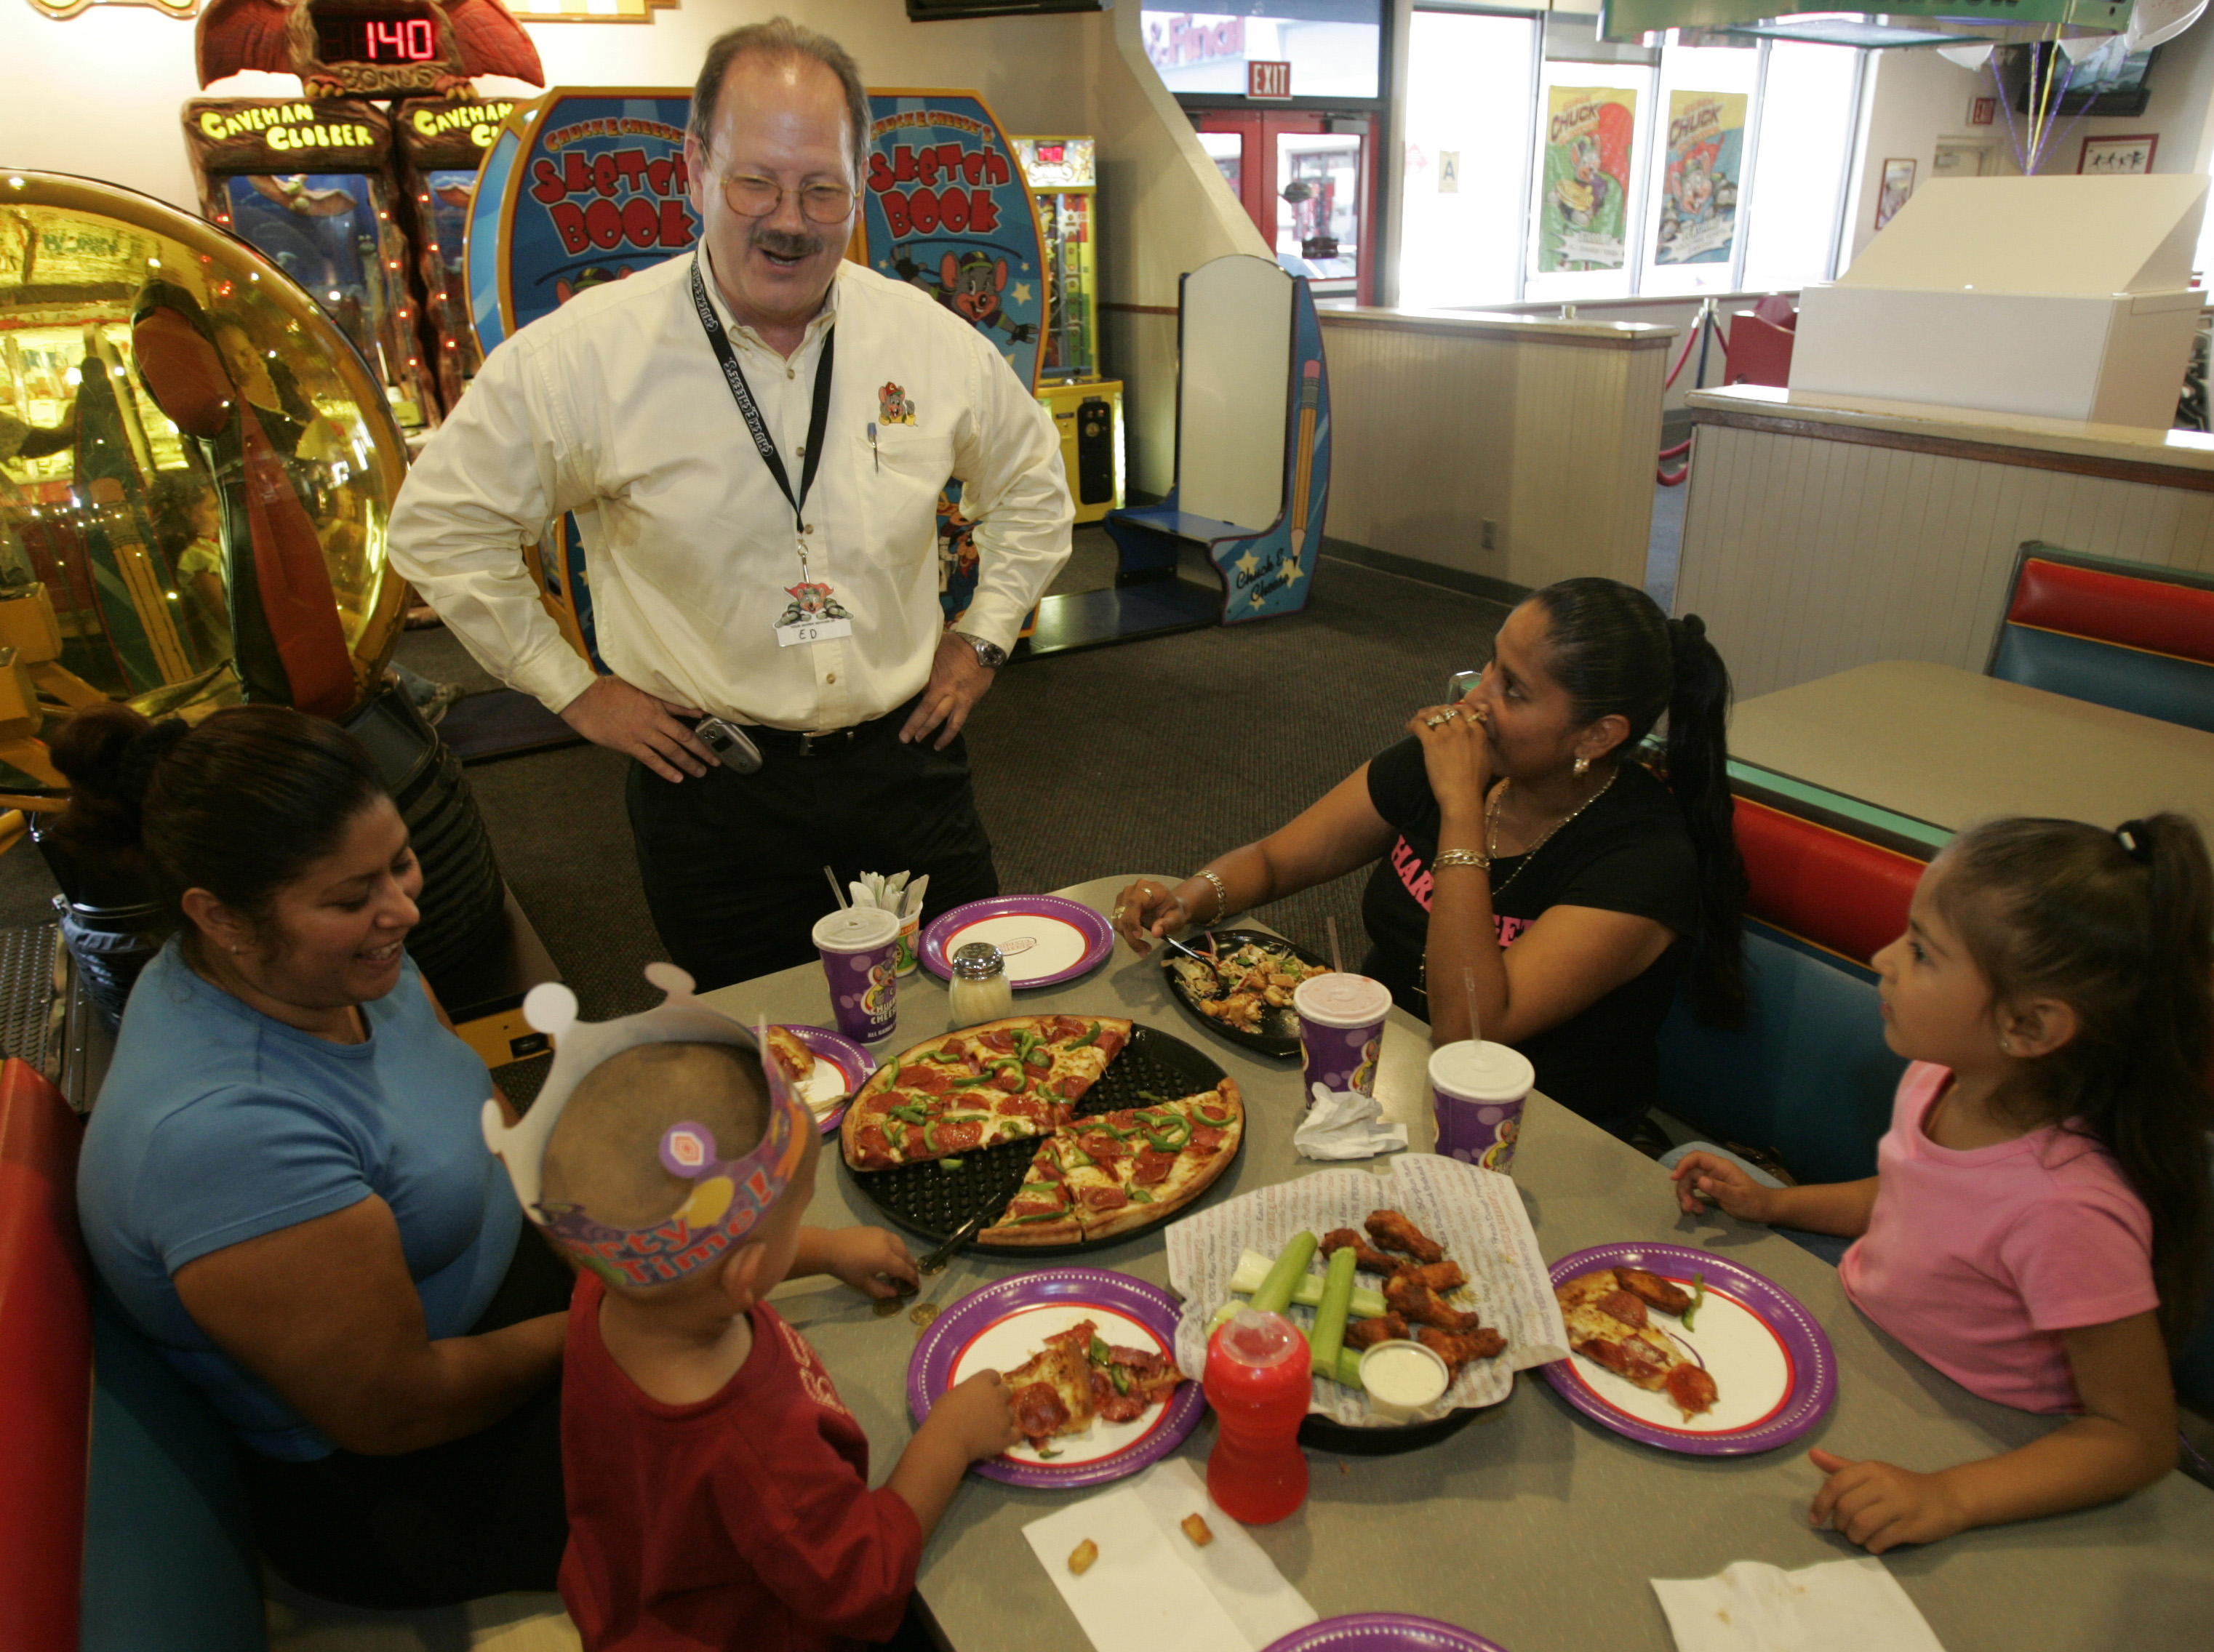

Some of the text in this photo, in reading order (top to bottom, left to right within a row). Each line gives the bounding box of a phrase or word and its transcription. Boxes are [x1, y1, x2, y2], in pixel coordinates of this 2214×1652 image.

[367, 20, 435, 60] 140
[1170, 13, 1244, 63] Final
[341, 68, 433, 91] BONUS
[1254, 64, 1287, 95] EXIT
[201, 103, 314, 140] CAVEMAN
[413, 103, 514, 137] CAVEMAN
[545, 119, 604, 151] CHUCK
[621, 118, 686, 144] CHEESE'
[266, 125, 374, 151] CLOBBER
[1442, 160, 1455, 180] A
[1236, 555, 1274, 590] Chuck
[560, 1218, 691, 1259] rty
[1208, 1281, 1217, 1303] 100%
